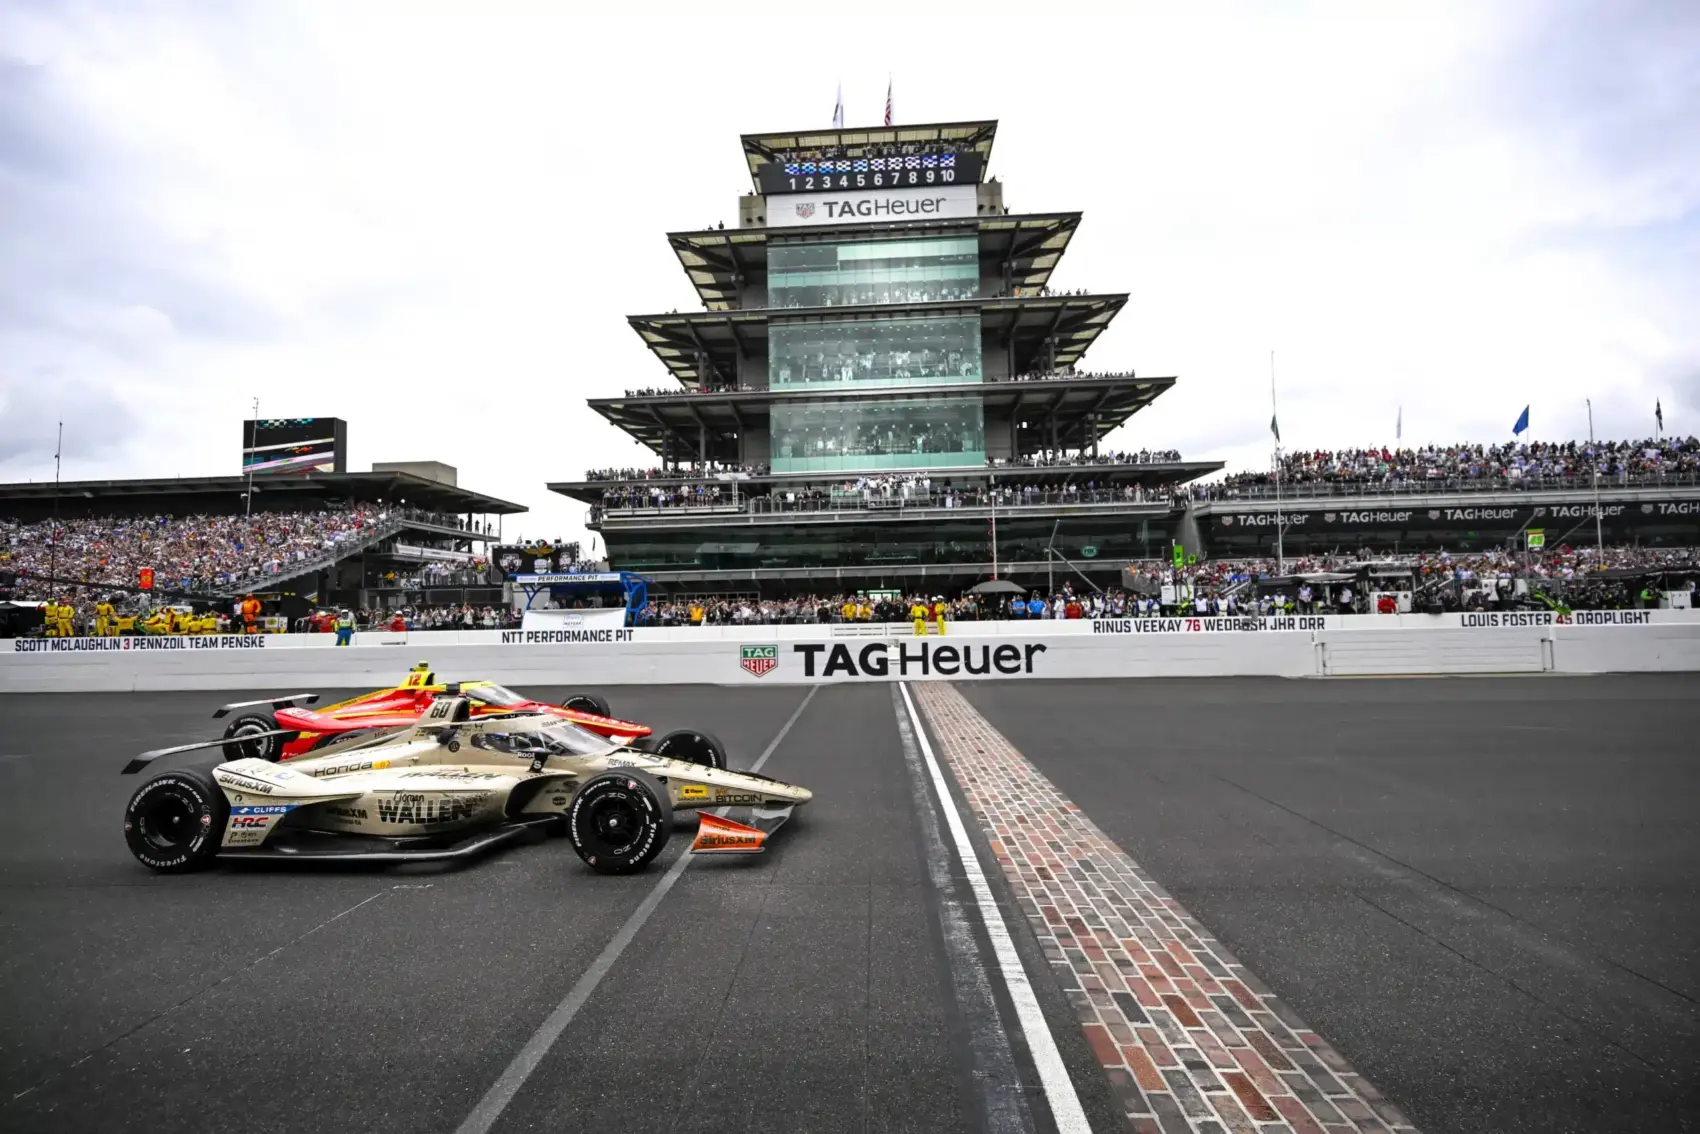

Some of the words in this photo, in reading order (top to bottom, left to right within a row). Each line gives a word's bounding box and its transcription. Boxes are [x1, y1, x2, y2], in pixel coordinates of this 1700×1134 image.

[789, 178, 797, 190] 1
[805, 177, 814, 189] 2
[822, 176, 831, 188] 3
[839, 175, 848, 187] 4
[856, 174, 865, 186] 5
[873, 173, 883, 185] 6
[891, 173, 900, 185] 7
[908, 172, 917, 184] 8
[926, 171, 935, 183] 9
[941, 170, 955, 182] 10
[1093, 619, 1131, 633] RINUS
[1134, 619, 1183, 633] VEEKAY
[1185, 619, 1201, 632] 76
[1270, 617, 1296, 630] JHR
[1299, 617, 1325, 630] DRR
[1461, 614, 1499, 627] LOUIS
[1502, 613, 1551, 626] FOSTER
[1576, 611, 1651, 625] DROPLIGHT
[15, 639, 49, 652] SCOTT
[51, 638, 121, 651] MCLAUGHLIN
[123, 638, 130, 650] 3
[133, 637, 187, 650] PENNZOIL
[188, 636, 218, 649] TEAM
[221, 635, 265, 648] PENSKE
[502, 631, 524, 644] NTT
[527, 629, 612, 643] PERFORMANCE
[615, 629, 634, 642] PIT
[744, 648, 774, 657] TAG
[743, 659, 775, 674] HEUER
[408, 673, 422, 686] 12
[430, 701, 452, 718] 60
[314, 761, 373, 777] Honda
[219, 773, 274, 795] SiriusXM
[715, 794, 762, 803] BITCOIN
[253, 806, 287, 814] CLIFFS
[377, 798, 473, 824] WALLEN
[140, 853, 187, 867] Firestone
